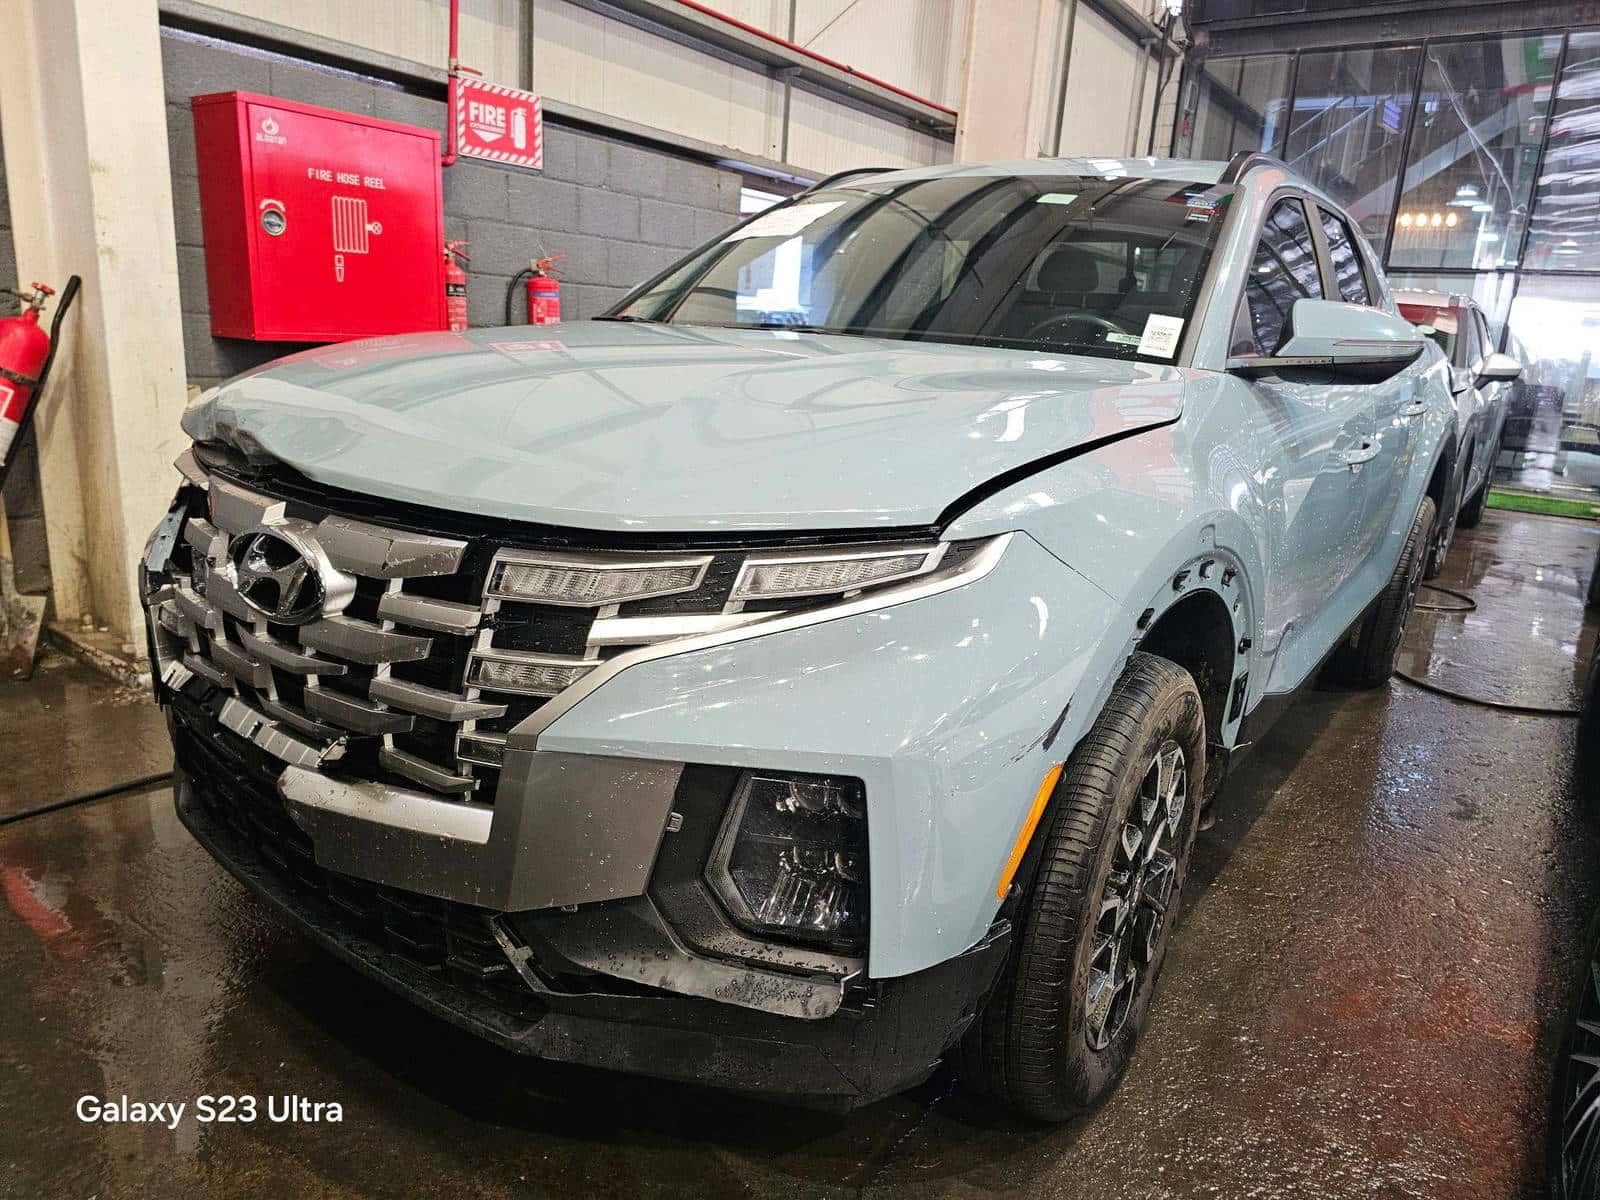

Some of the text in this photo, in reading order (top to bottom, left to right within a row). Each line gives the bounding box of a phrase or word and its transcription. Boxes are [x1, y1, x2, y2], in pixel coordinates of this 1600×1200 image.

[469, 101, 506, 127] FIRE
[308, 167, 386, 190] FIRE HOSE REEL
